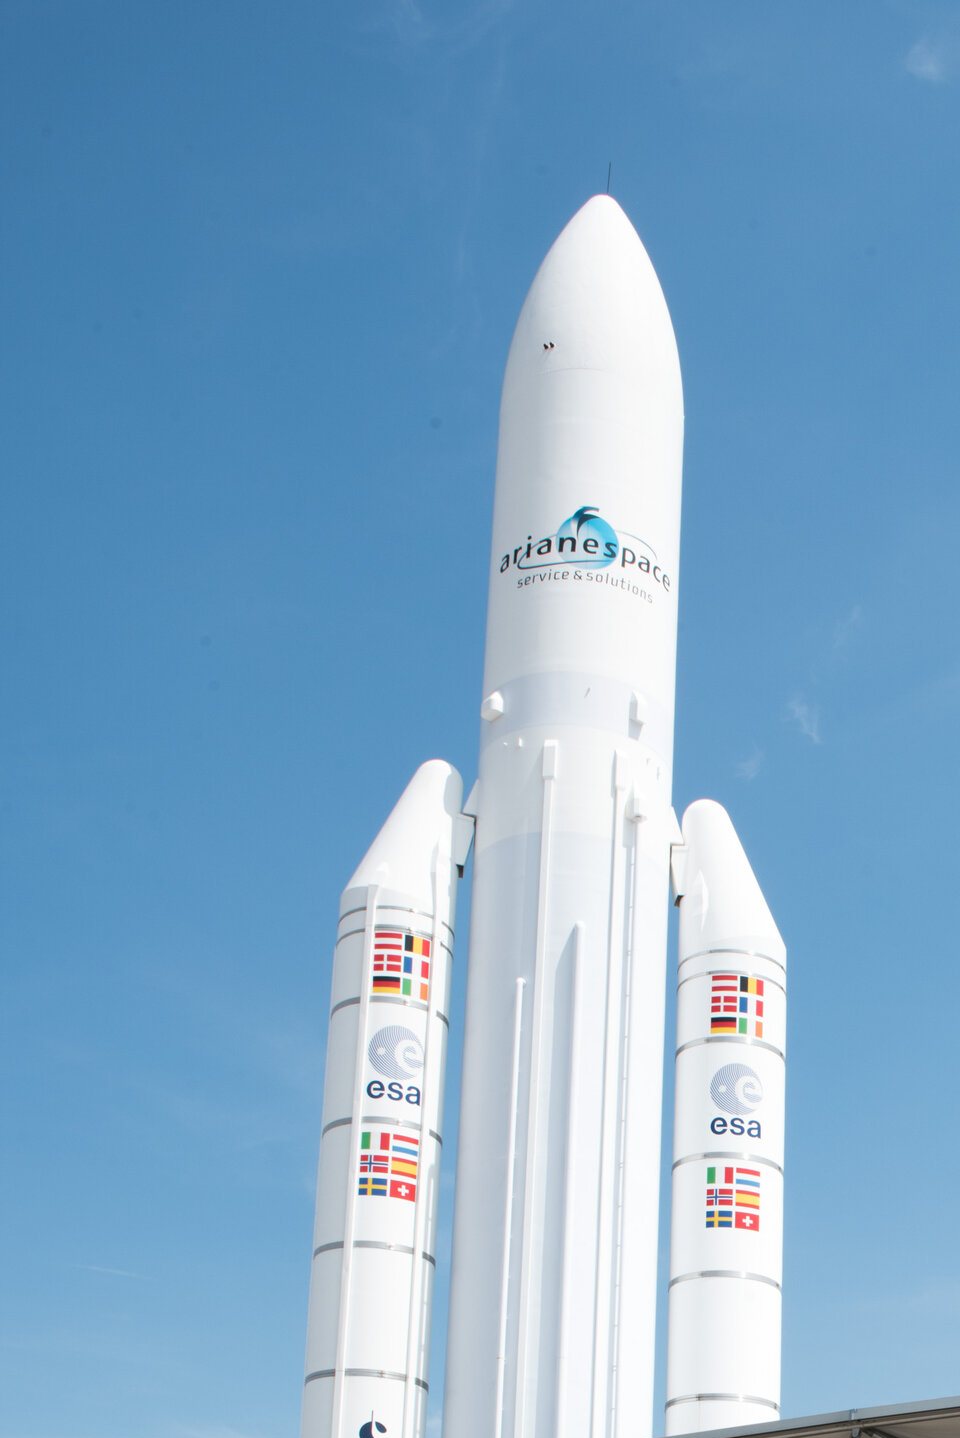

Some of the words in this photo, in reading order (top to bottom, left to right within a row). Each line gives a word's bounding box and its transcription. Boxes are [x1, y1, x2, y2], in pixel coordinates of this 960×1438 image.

[500, 535, 671, 592] arianespace
[517, 569, 570, 589] service
[573, 570, 583, 581] &
[586, 572, 654, 604] solutions
[366, 1080, 421, 1106] esa
[710, 1116, 762, 1139] esa
